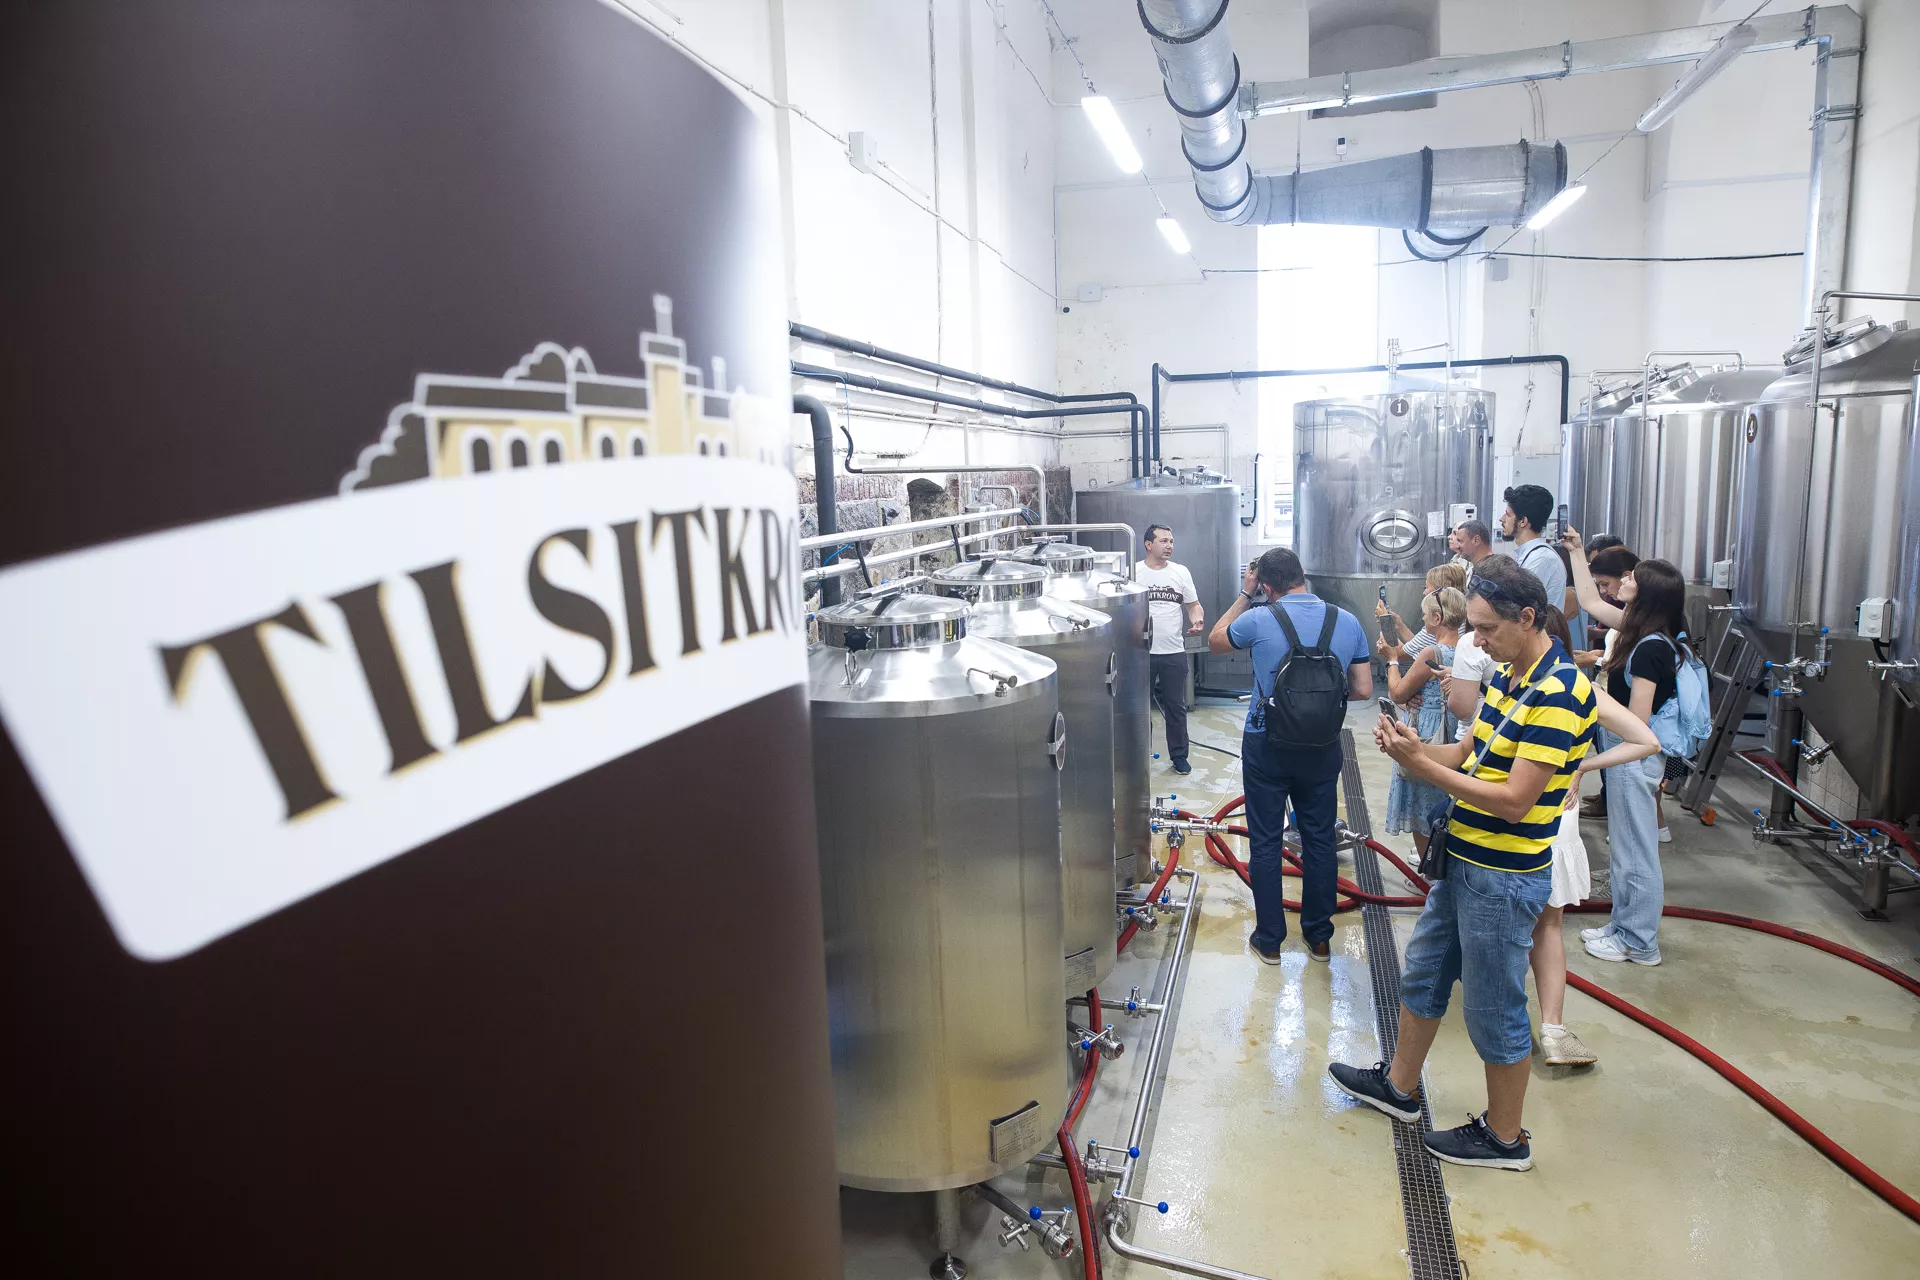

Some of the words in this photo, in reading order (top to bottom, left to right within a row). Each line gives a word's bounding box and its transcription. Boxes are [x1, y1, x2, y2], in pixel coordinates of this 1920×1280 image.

[1397, 402, 1403, 414] 1
[1748, 420, 1755, 437] 4
[1148, 592, 1180, 602] ITKRONE
